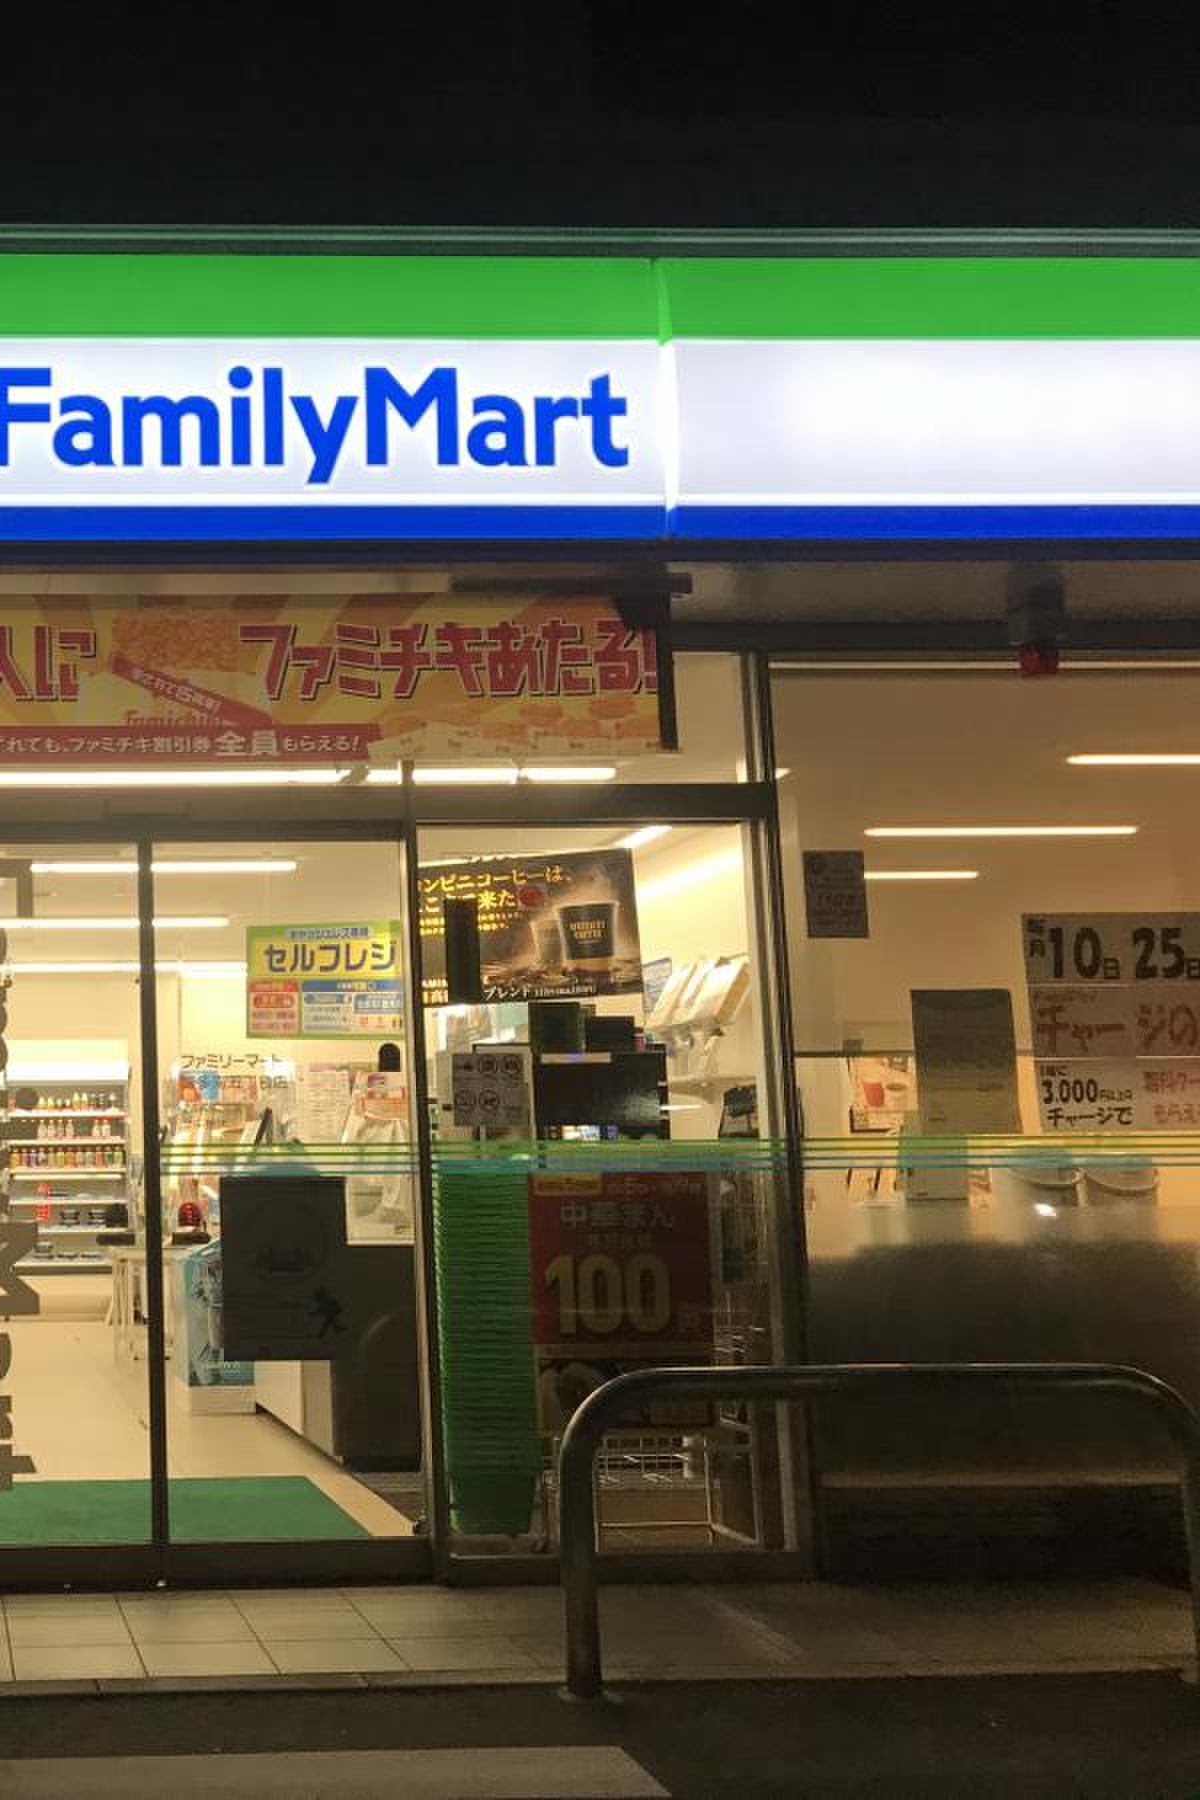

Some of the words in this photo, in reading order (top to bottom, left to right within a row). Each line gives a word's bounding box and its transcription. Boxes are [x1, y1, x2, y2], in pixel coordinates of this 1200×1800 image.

[263, 940, 398, 973] セルフレジ
[179, 1053, 284, 1069] ファミリーマート
